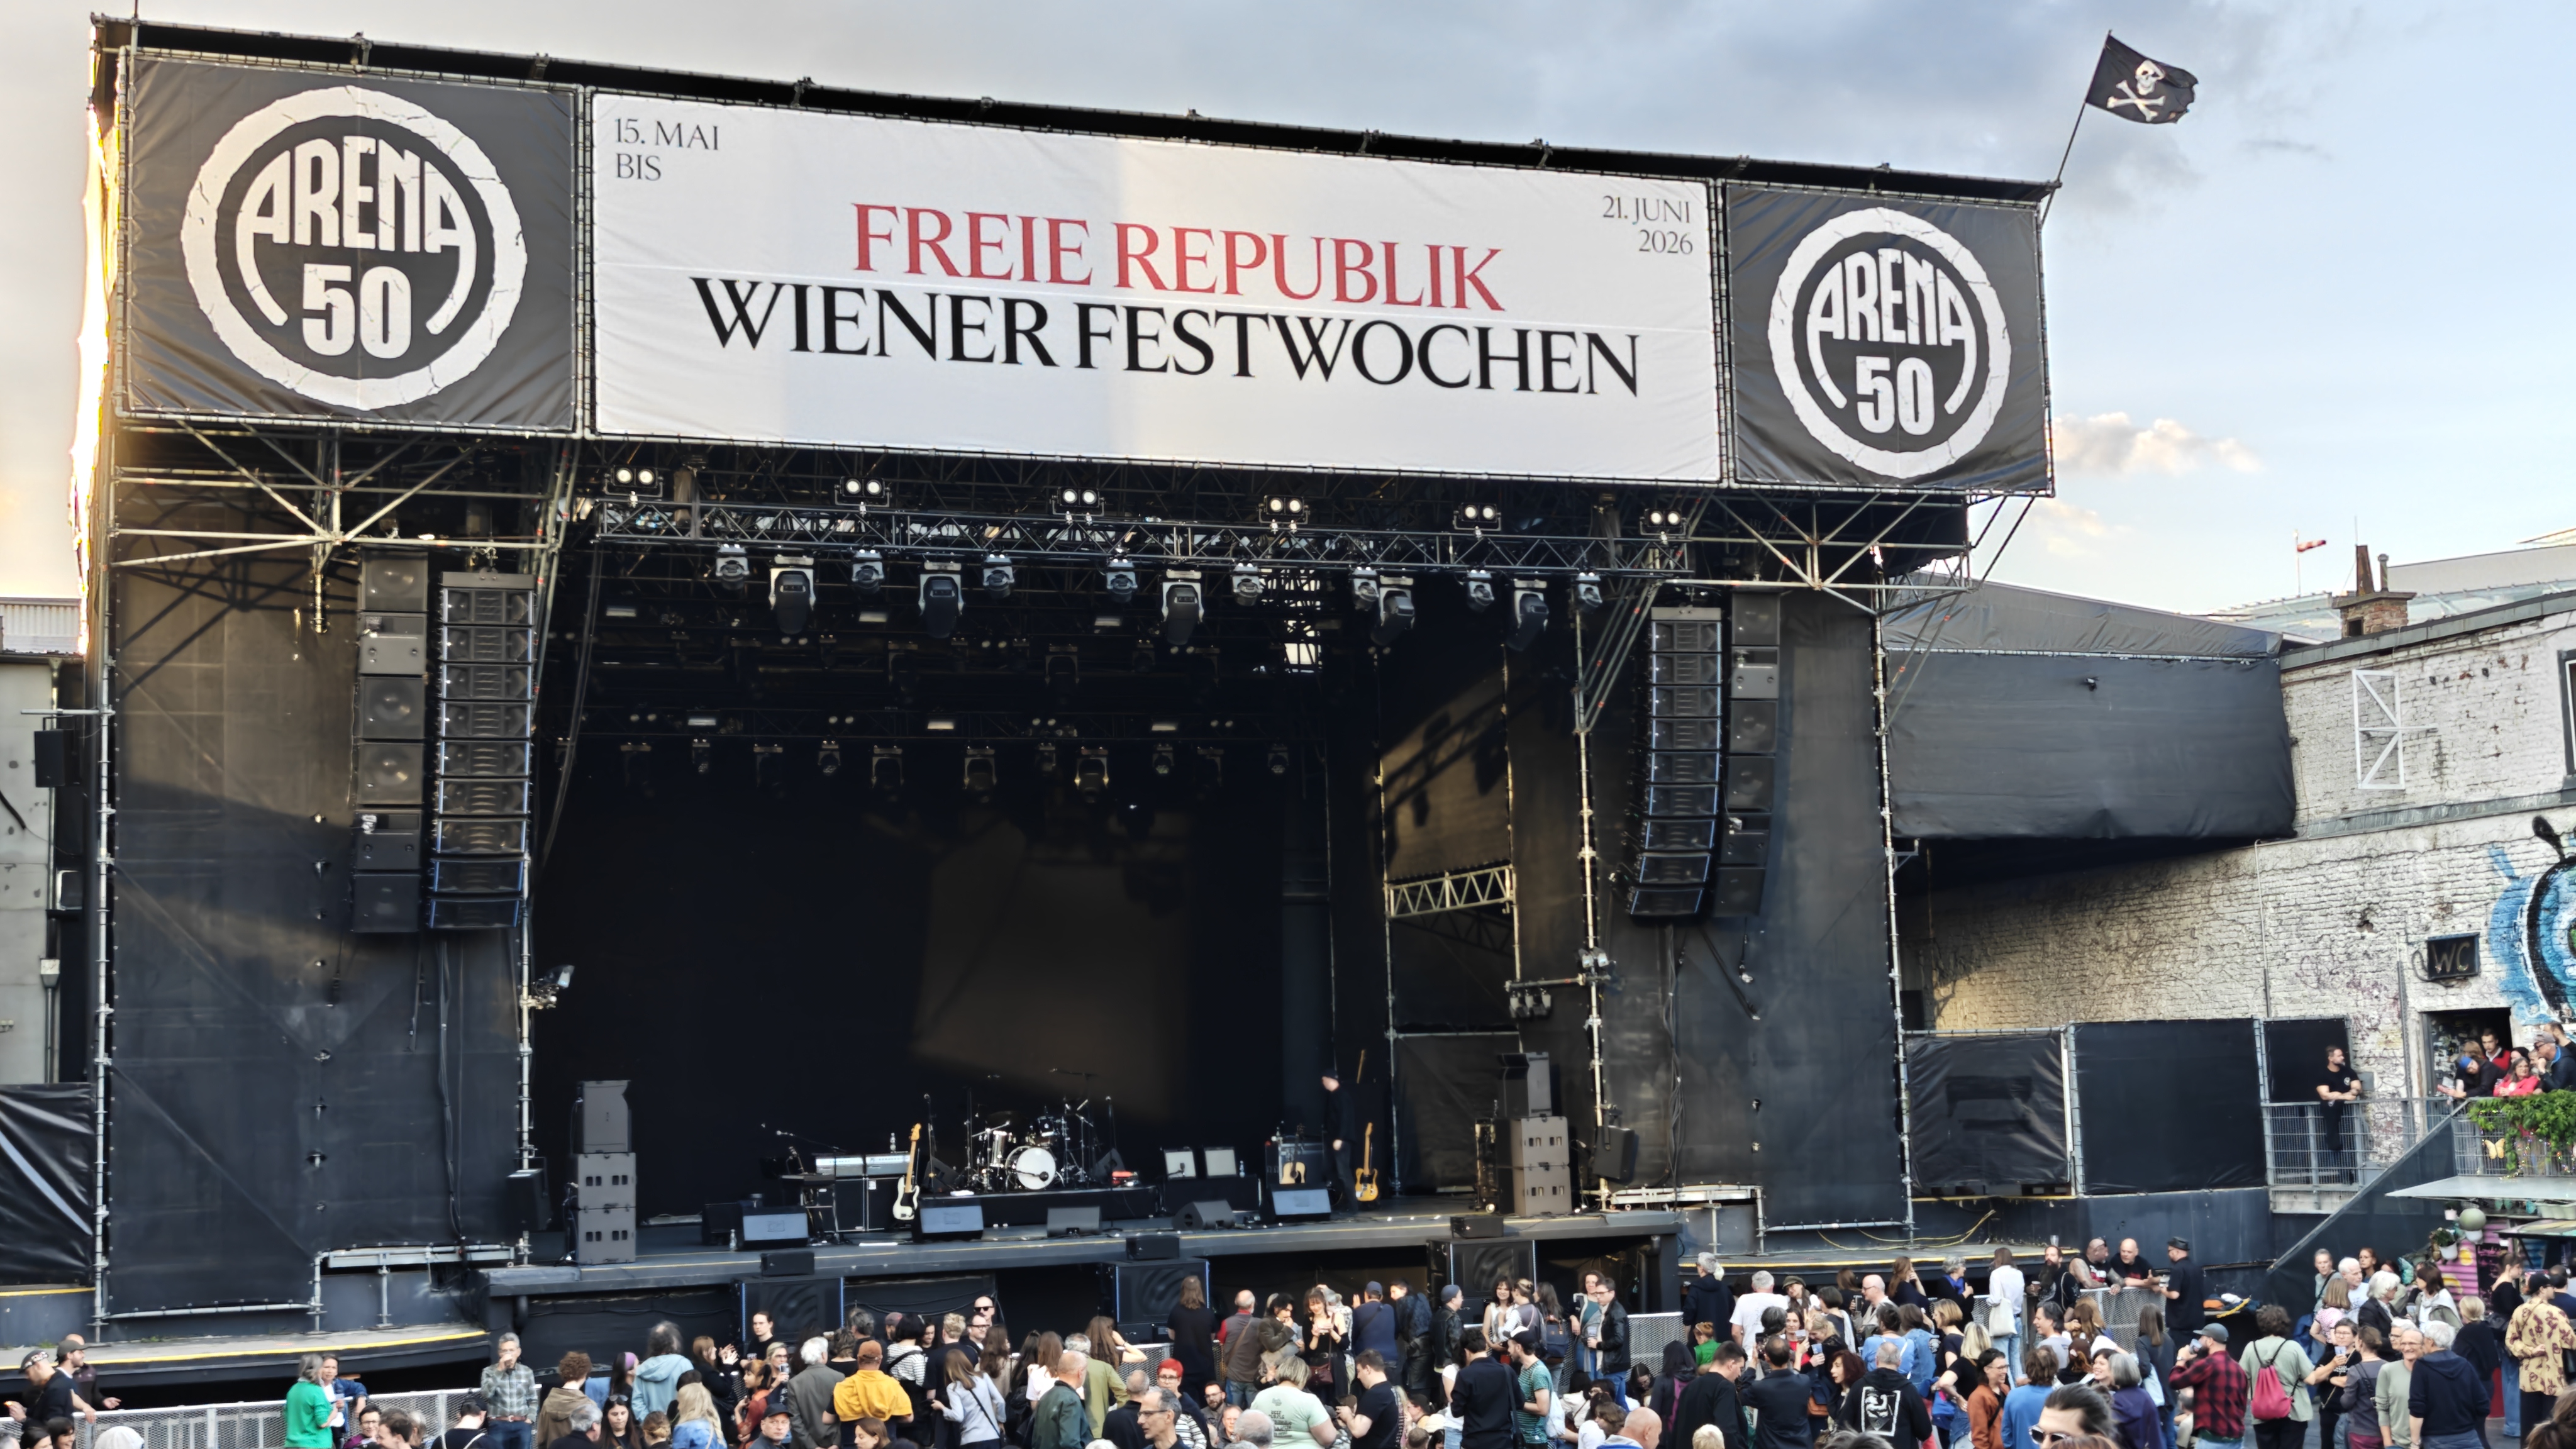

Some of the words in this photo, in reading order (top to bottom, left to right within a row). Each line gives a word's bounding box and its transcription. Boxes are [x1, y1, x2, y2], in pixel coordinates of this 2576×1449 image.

[615, 118, 645, 144] 15.
[655, 120, 719, 150] MAI
[616, 153, 662, 180] BIS
[236, 135, 477, 335] ARENA
[1603, 195, 1628, 219] 21.
[1632, 197, 1690, 225] JUNI
[1639, 229, 1693, 255] 2026
[855, 204, 1092, 286] FREIE
[1114, 223, 1504, 311] REPUBLIK
[302, 263, 413, 360] 50
[691, 277, 1058, 367] WIENER
[1074, 303, 1638, 397] FESTWOCHEN
[1806, 248, 1977, 414] ARENA
[1856, 355, 1935, 436] 50
[2430, 941, 2470, 974] WC
